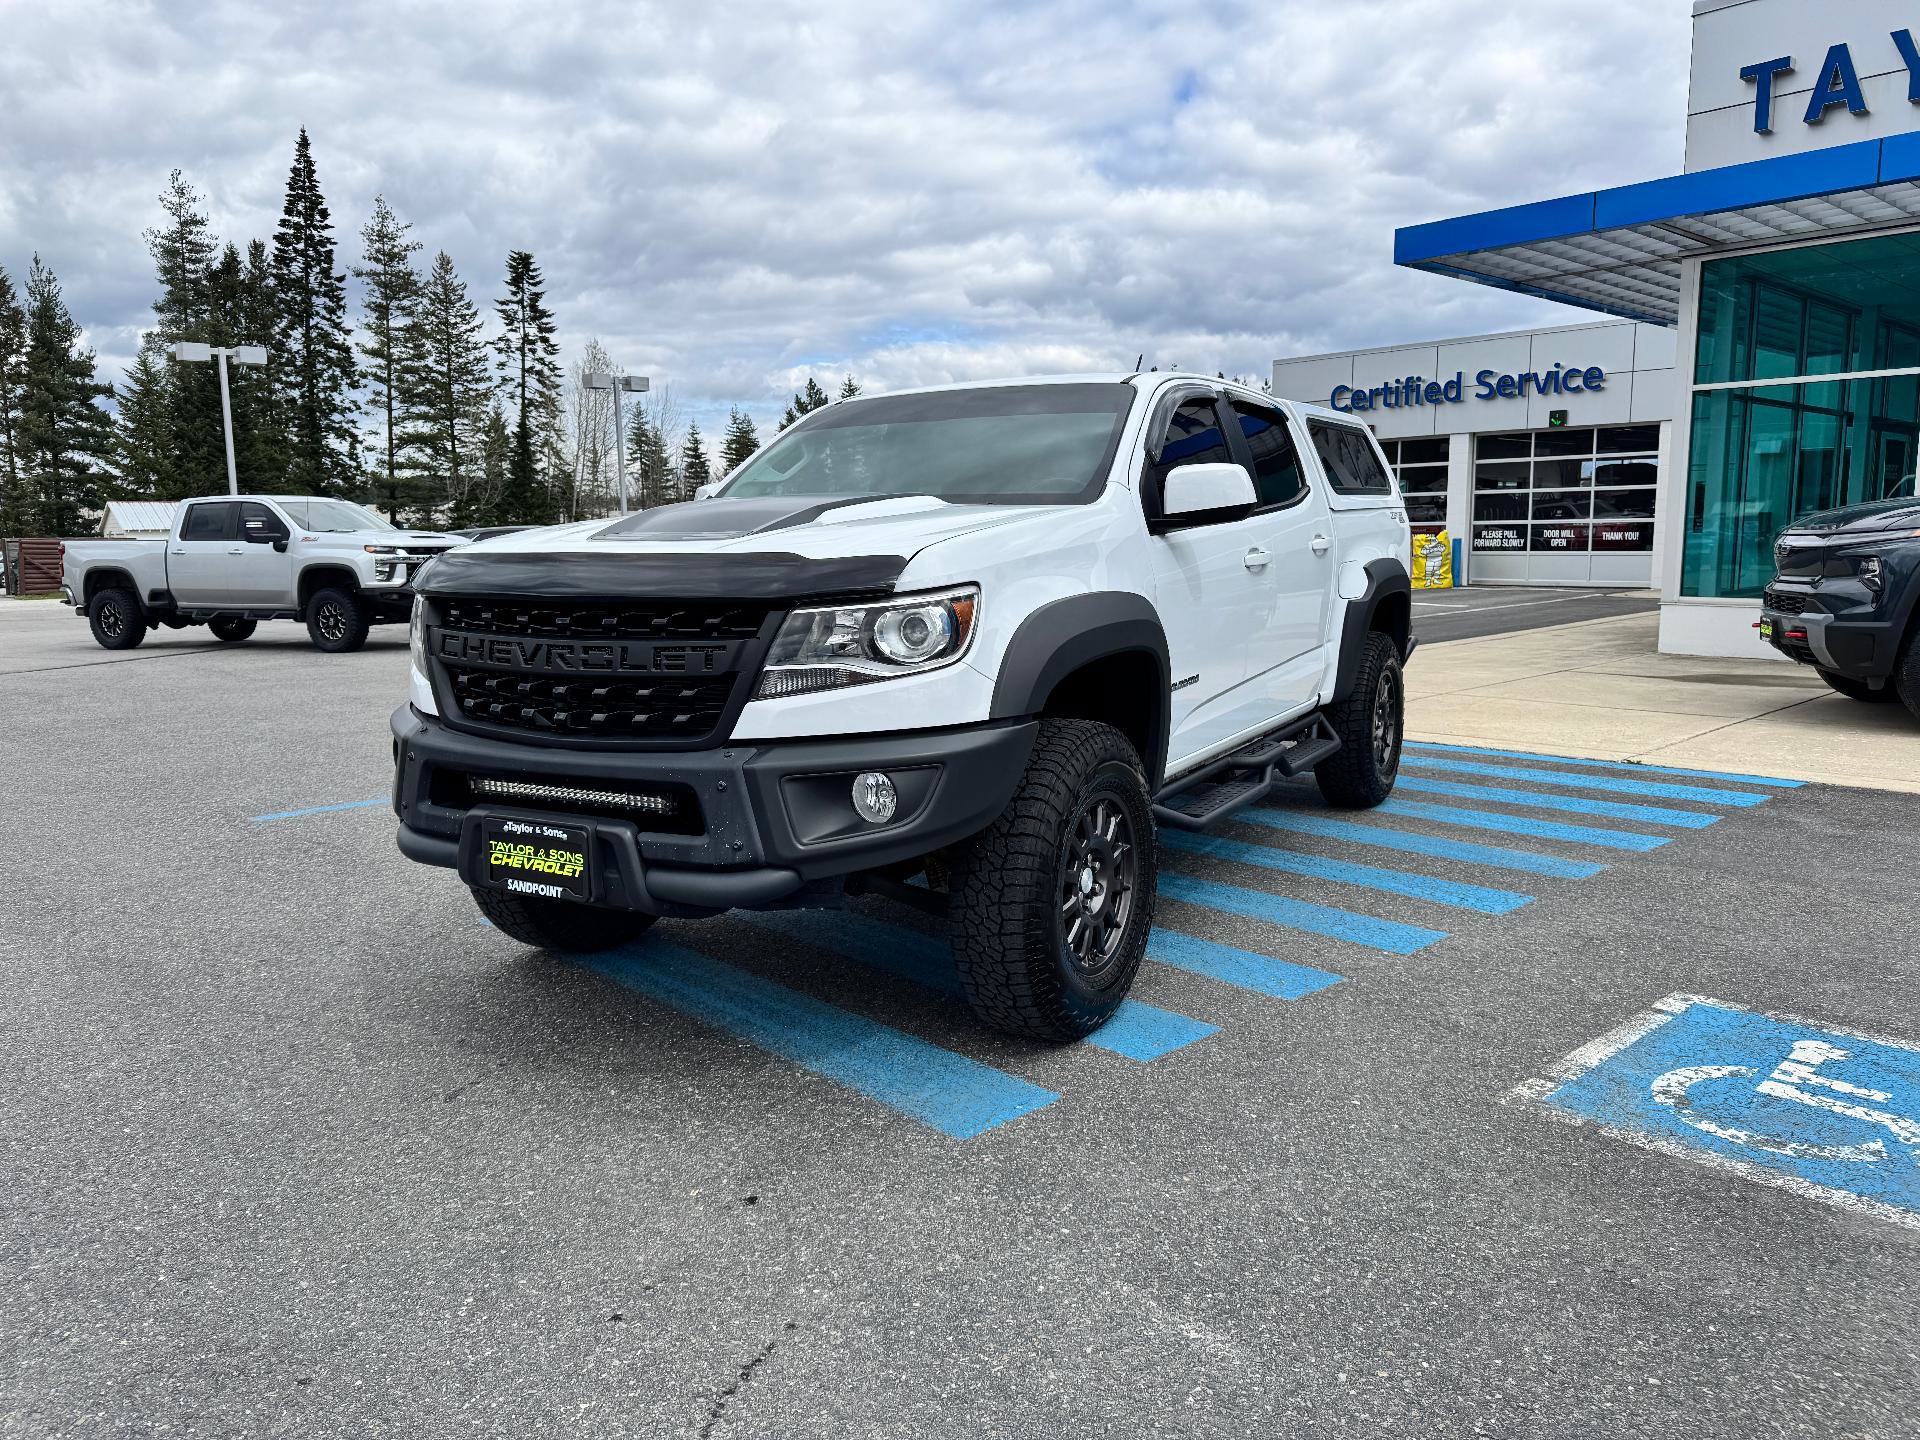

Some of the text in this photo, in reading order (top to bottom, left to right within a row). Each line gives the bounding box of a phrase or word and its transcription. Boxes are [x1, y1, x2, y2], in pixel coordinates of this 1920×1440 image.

[1330, 362, 1605, 413] Certified Service
[1481, 529, 1517, 539] PLEASE PULL
[1543, 529, 1575, 538] DOOR WILL
[1602, 531, 1640, 541] THANK YOU!
[1474, 538, 1525, 548] FORWARD SLOWLY
[1550, 538, 1567, 547] OPEN
[440, 633, 728, 672] CHEVROLET
[506, 821, 564, 838] Taylor & Sons
[489, 840, 584, 864] TAYLOR & SONS
[490, 852, 584, 878] CHEVROLET
[507, 879, 564, 898] SANDPOINT
